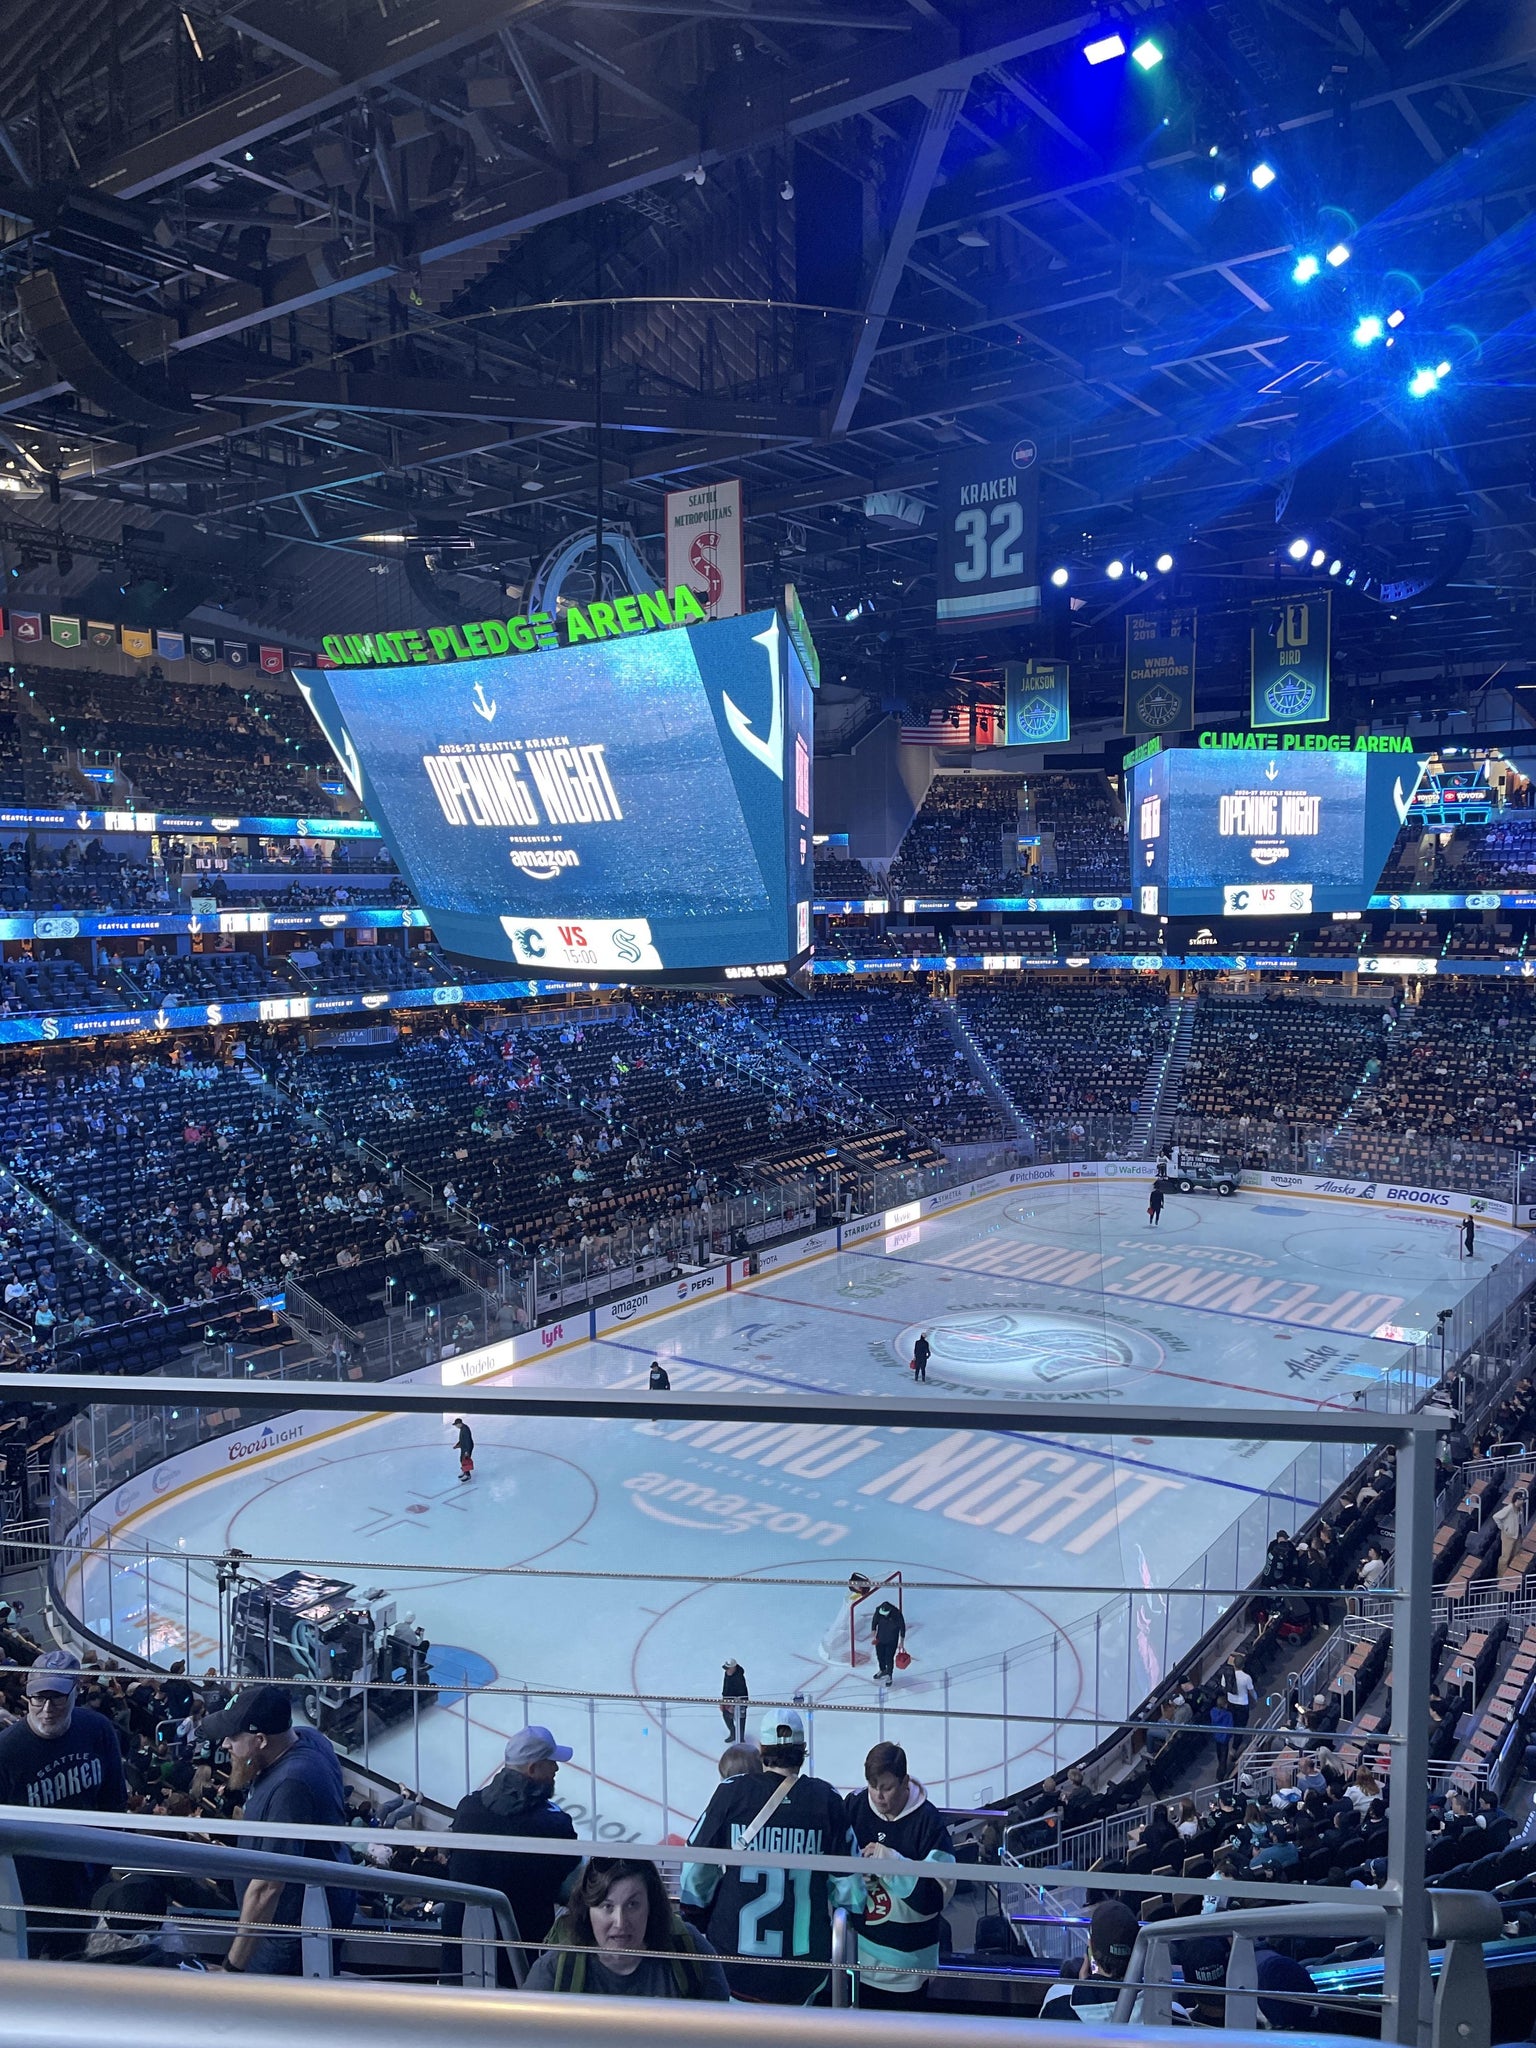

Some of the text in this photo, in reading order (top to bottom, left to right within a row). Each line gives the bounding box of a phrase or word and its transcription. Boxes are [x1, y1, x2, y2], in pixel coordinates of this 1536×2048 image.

[688, 491, 717, 507] SEATTLE
[960, 476, 1017, 506] KRAKEN
[674, 505, 733, 528] METROPOLITANS
[955, 501, 1024, 583] 32
[322, 584, 706, 665] CLIMATE PLEDGE ARENA
[1144, 656, 1175, 668] WNBA
[1279, 649, 1301, 666] BIRD
[1020, 674, 1056, 692] JACKSON
[1131, 665, 1189, 680] CHAMPIONS
[438, 735, 570, 754] 2026-27 SEATTLE KRAKEN
[1199, 731, 1413, 753] CLIMATE PLEDGE ARENA
[422, 743, 624, 826] OPENING NIGHT
[1416, 793, 1440, 801] TOYOTA
[1456, 792, 1485, 800] TOYOTA
[1219, 795, 1322, 836] OPENING NIGHT
[509, 835, 550, 843] PRESENTED
[509, 849, 581, 868] amazon
[1250, 847, 1290, 859] amazon
[1261, 888, 1276, 901] VS
[97, 922, 129, 930] SEATTLE
[557, 925, 588, 947] VS
[562, 948, 598, 964] 15:00
[73, 1021, 107, 1030] SEATTLE
[1015, 1168, 1055, 1183] PitchBook
[1270, 1175, 1303, 1185] amazon
[1313, 1180, 1356, 1195] Alaska
[1386, 1188, 1450, 1206] BROOKS
[843, 1218, 882, 1239] STARBUCKS
[759, 1254, 778, 1268] OYOTA
[1117, 1239, 1278, 1268] amazon
[691, 1276, 715, 1292] PEPSI
[611, 1294, 649, 1316] amazon
[1106, 1263, 1405, 1334] OPENING
[541, 1323, 564, 1348] lyft
[733, 1320, 813, 1352] SYMETRA
[946, 1301, 1191, 1352] CLIMATE PLEDGE ARENA
[460, 1355, 496, 1378] Modelo
[1284, 1345, 1341, 1380] Alaska
[228, 1425, 305, 1461] Coors LIGHT
[682, 1455, 867, 1512] PRESENTED BY
[856, 1429, 1187, 1555] NIGHT
[622, 1470, 851, 1546] amazon
[36, 1752, 90, 1778] SEATTLE
[26, 1757, 102, 1807] KRAKEN
[737, 1865, 812, 1958] 21
